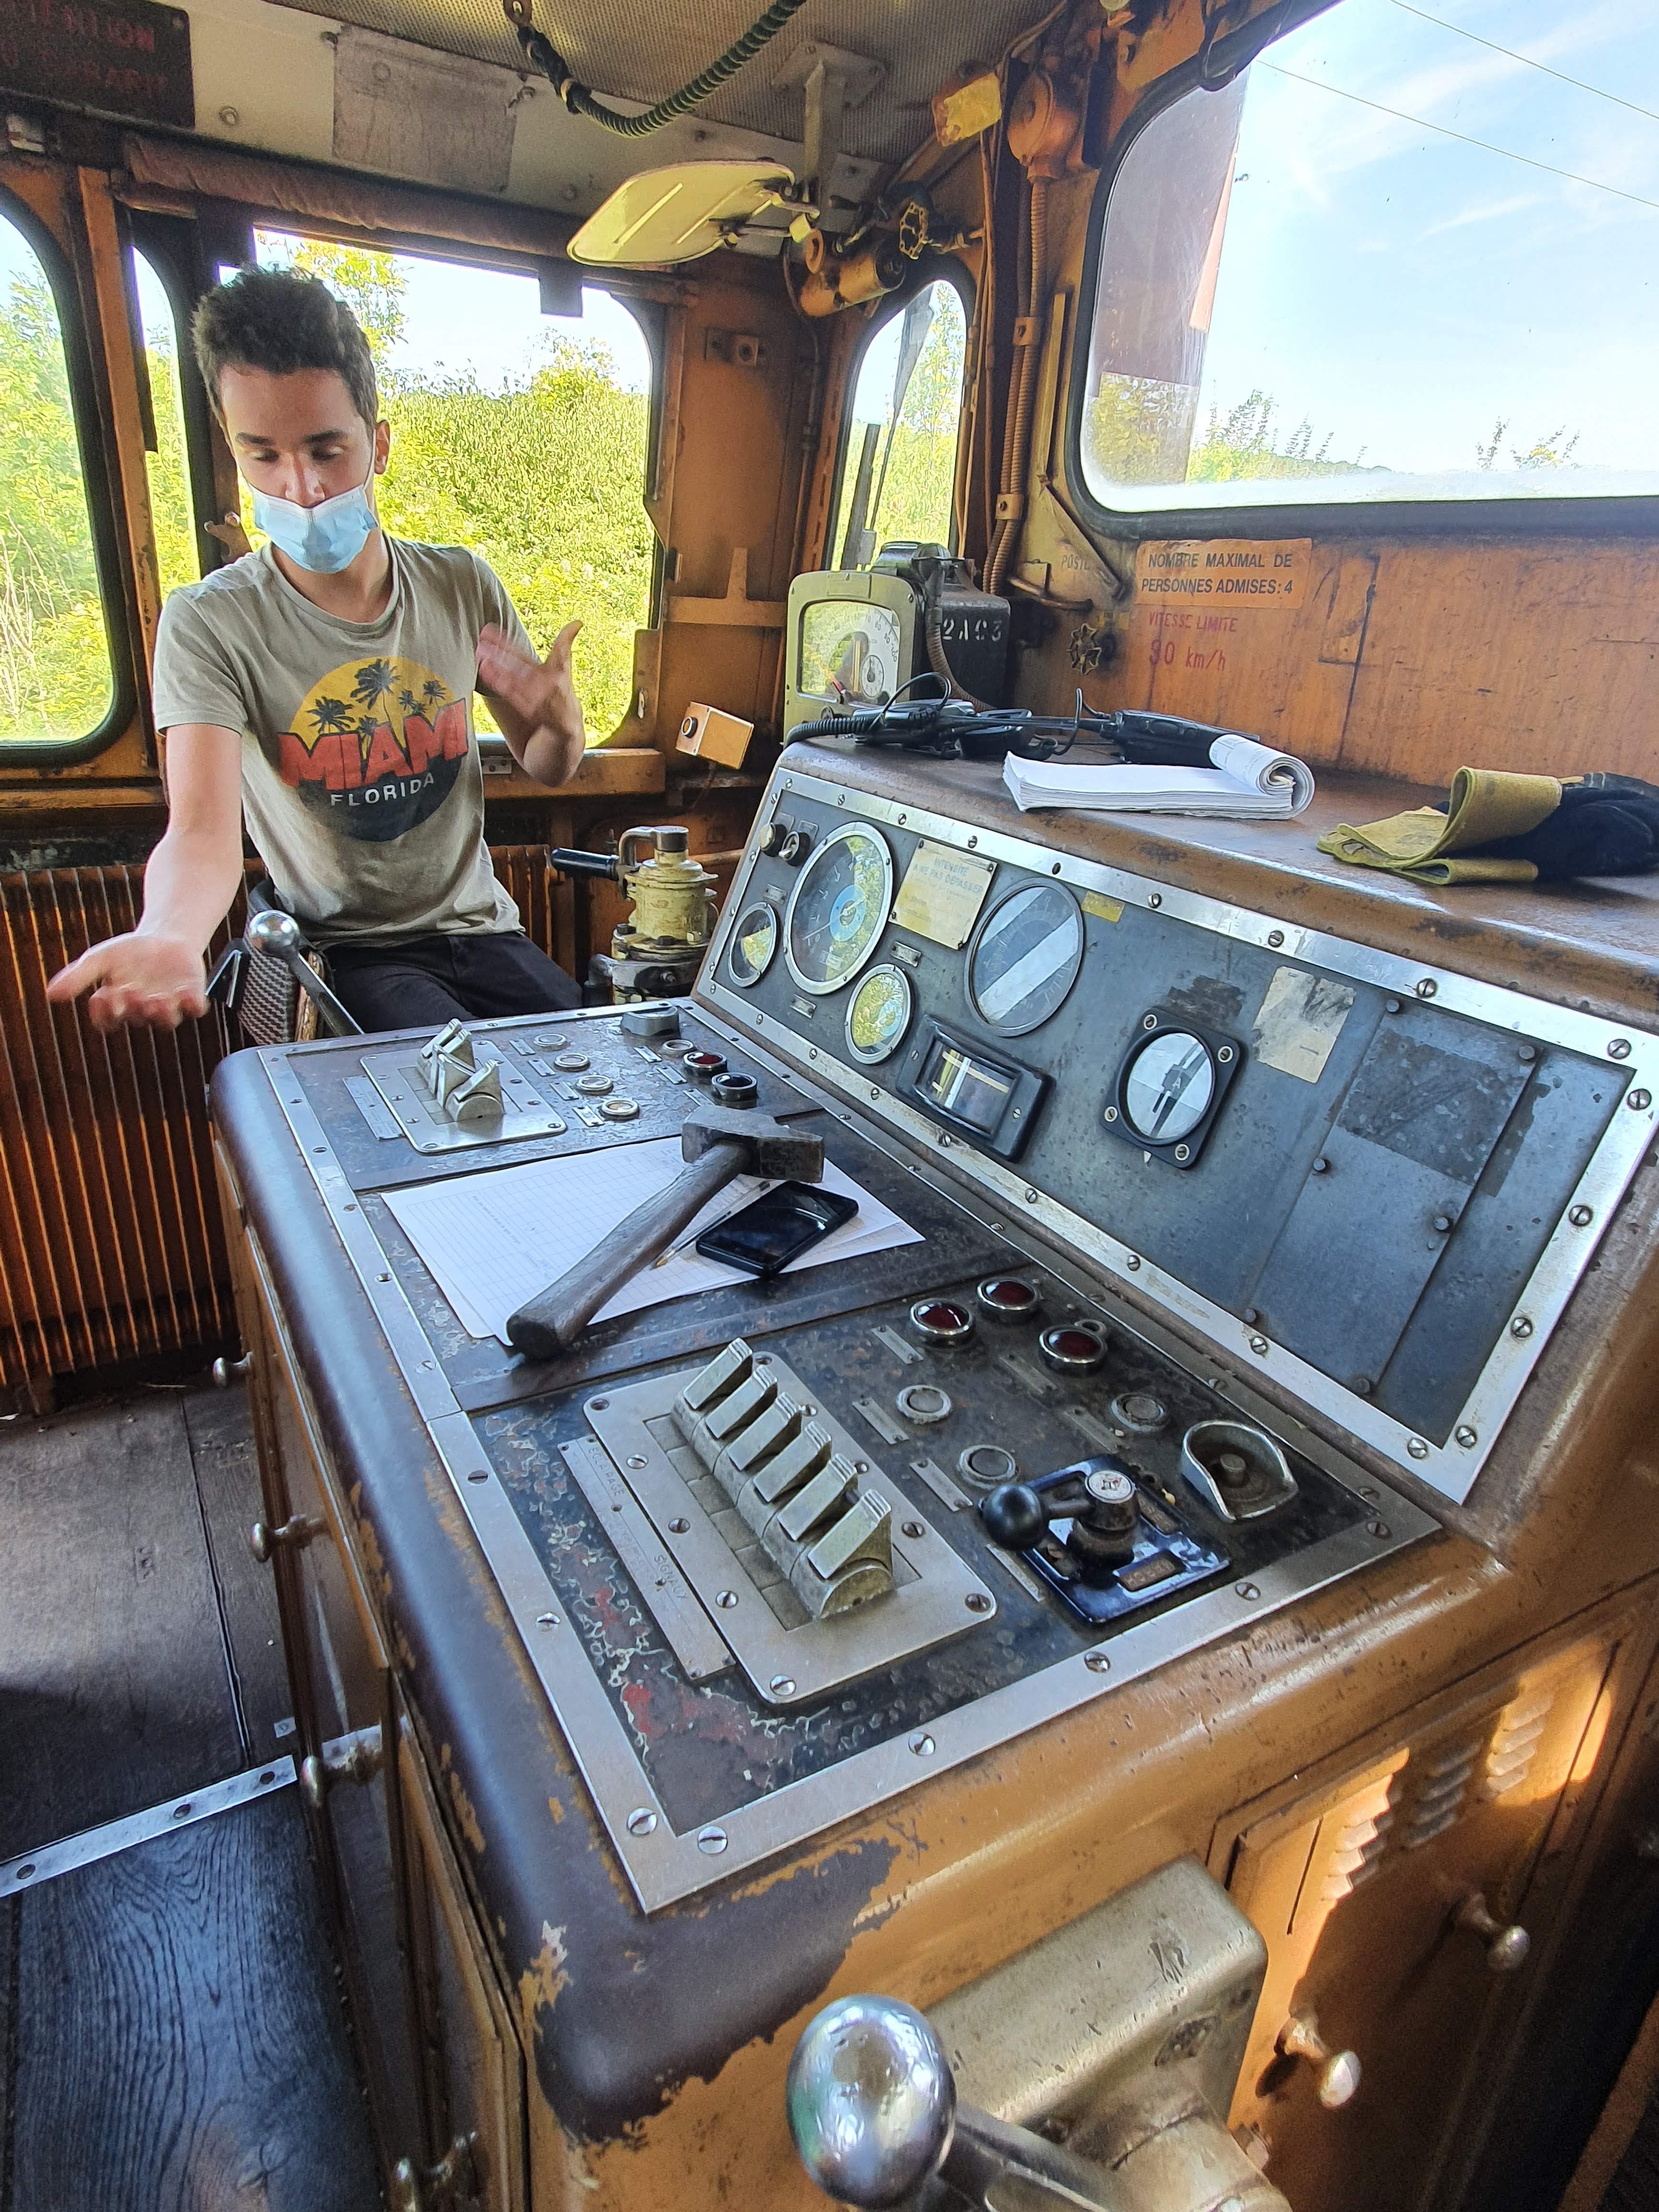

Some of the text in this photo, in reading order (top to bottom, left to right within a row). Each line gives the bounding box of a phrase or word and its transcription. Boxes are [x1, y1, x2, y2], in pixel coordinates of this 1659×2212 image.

[1148, 553, 1293, 568] NOMBRE MAXIMAL DE
[1141, 578, 1213, 594] PERSONNES
[1149, 612, 1238, 632] VITESSE LIMITE
[1185, 646, 1226, 672] km/h
[277, 697, 469, 791] MIAMI
[330, 772, 434, 807] FLORIDA
[589, 1447, 625, 1497] ECLAIRAGE
[654, 1555, 689, 1599] SIGNAUX
